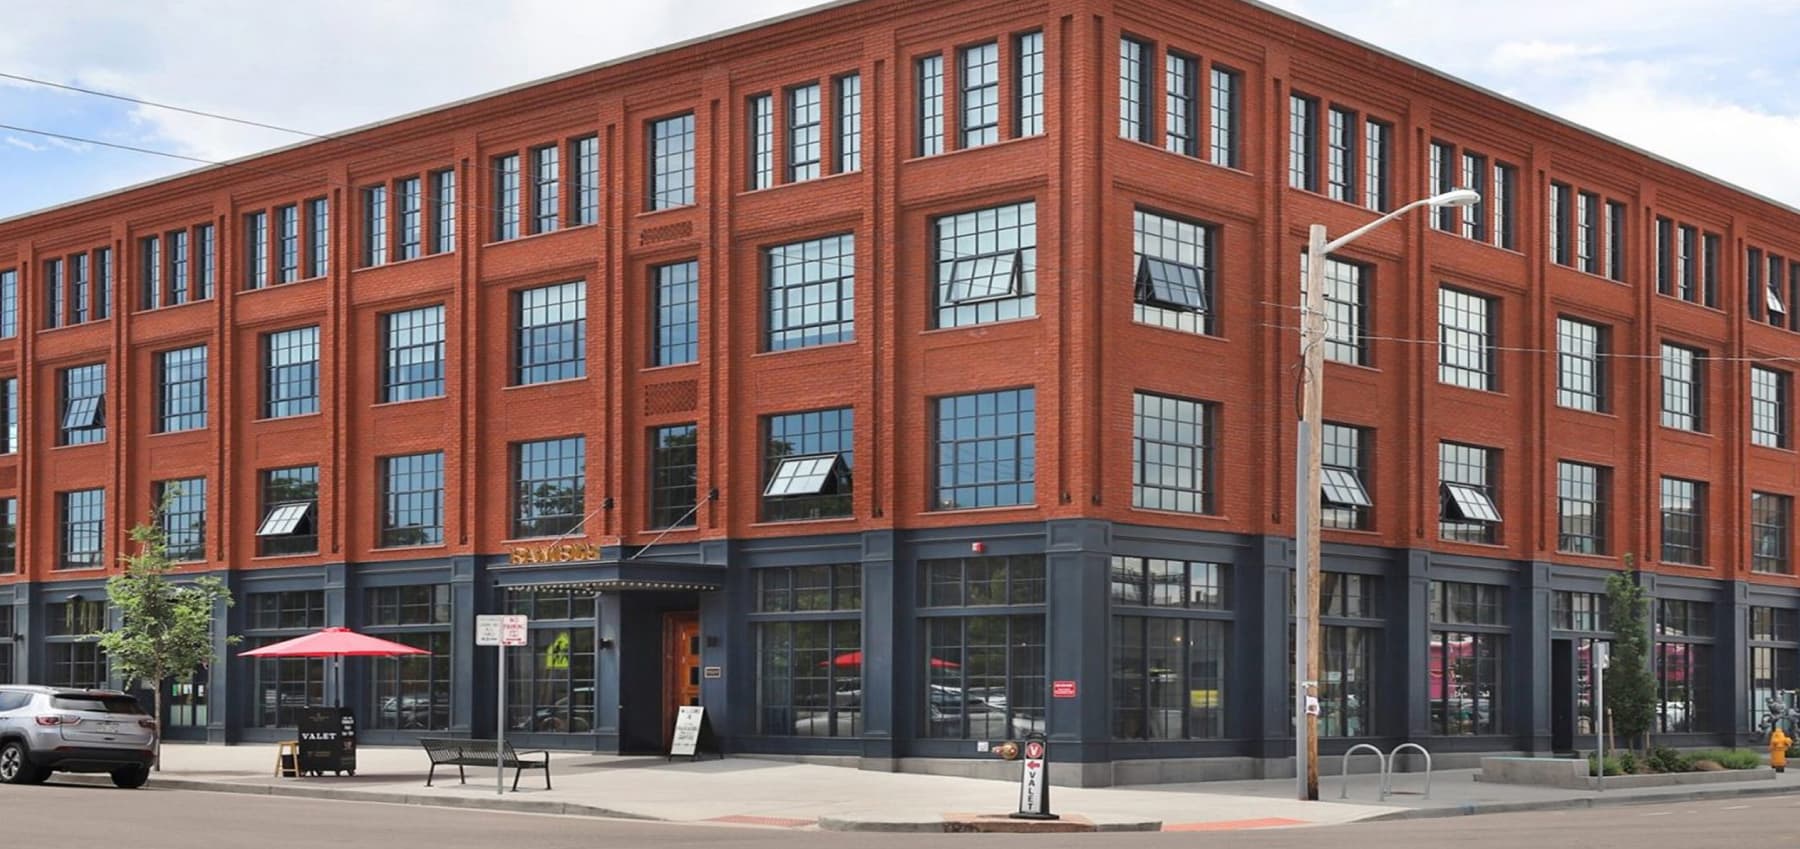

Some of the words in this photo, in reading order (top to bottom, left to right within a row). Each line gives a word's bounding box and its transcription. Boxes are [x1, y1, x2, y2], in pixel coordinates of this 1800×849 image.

[301, 732, 337, 740] VALET
[1029, 745, 1039, 756] V
[1027, 771, 1036, 811] VALET
